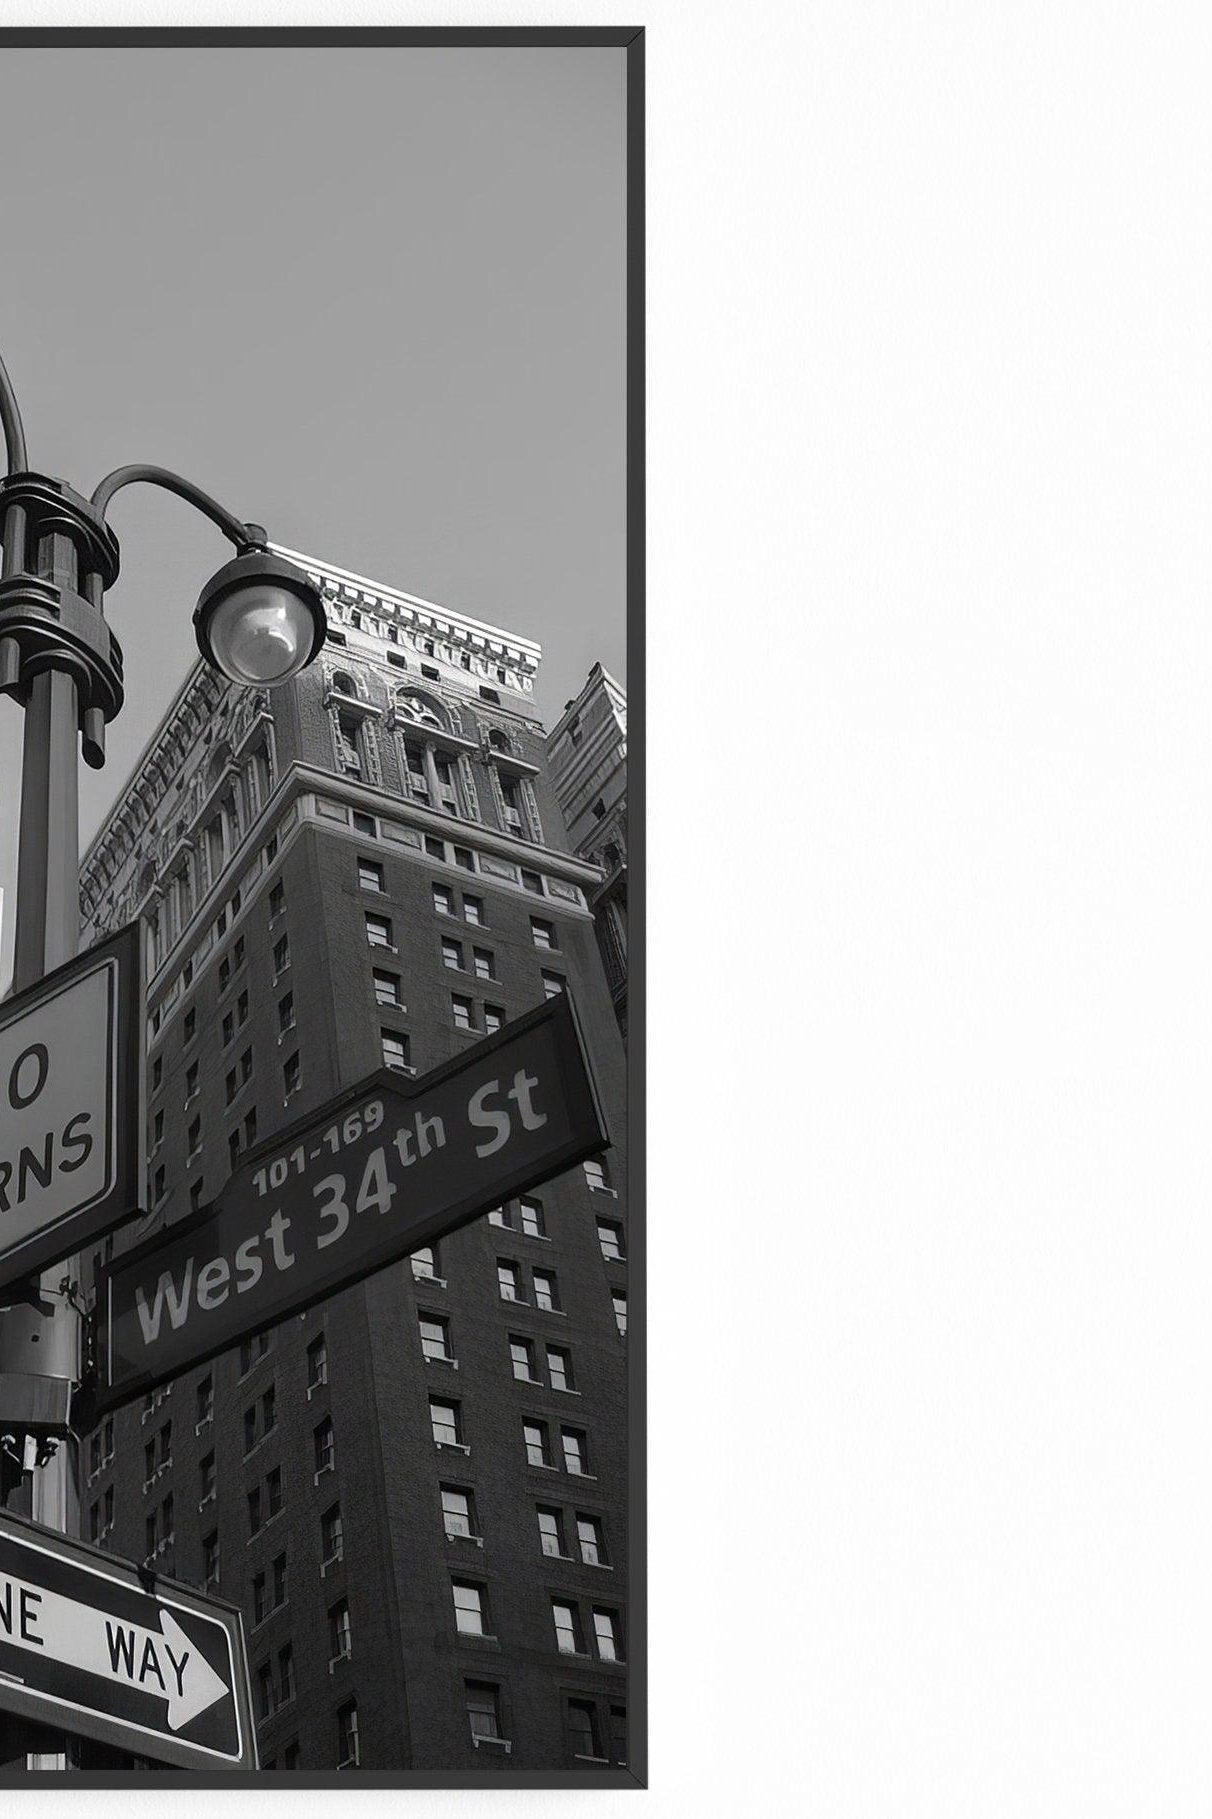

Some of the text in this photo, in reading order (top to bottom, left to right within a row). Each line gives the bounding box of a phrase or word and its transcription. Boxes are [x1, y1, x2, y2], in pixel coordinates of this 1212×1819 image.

[252, 1101, 385, 1196] 101-169
[135, 1068, 548, 1344] West 34th St
[105, 1620, 189, 1698] WAY
